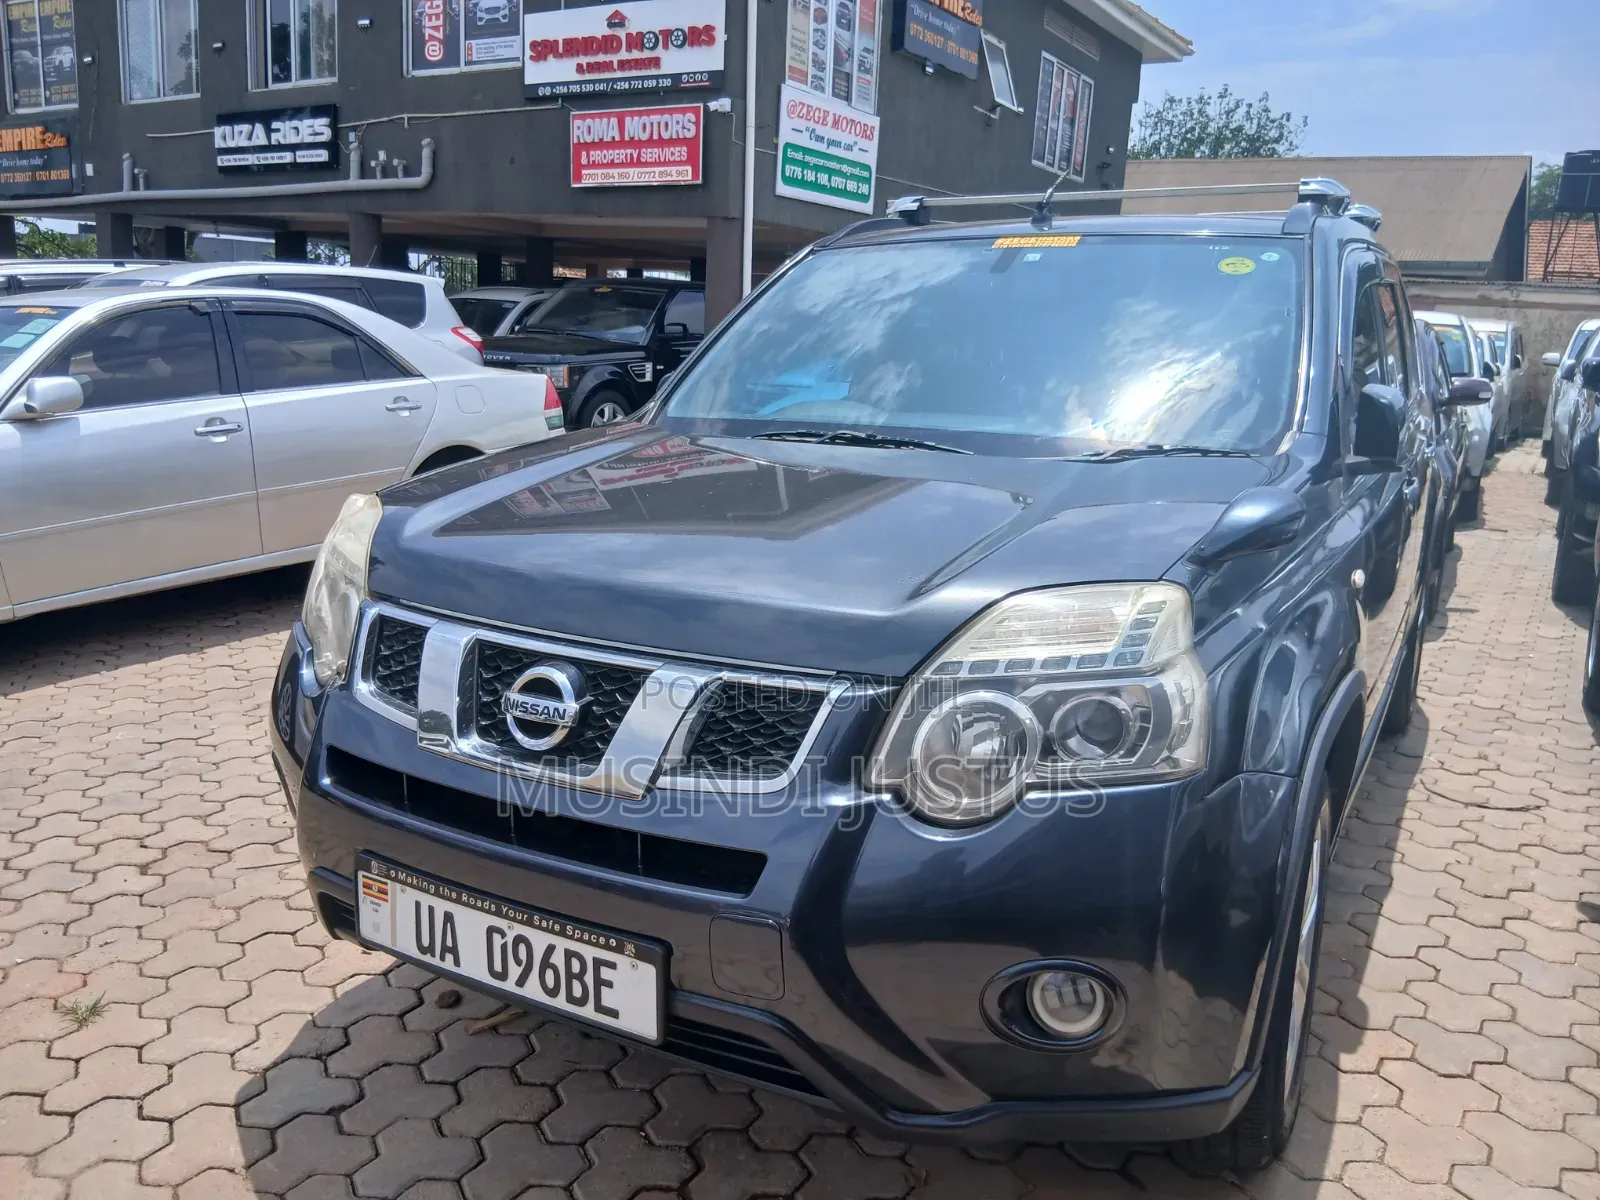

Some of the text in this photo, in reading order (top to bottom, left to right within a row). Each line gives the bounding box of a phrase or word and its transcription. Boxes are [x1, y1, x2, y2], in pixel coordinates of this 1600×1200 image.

[529, 24, 716, 63] SPLENDID MOTORS
[576, 56, 661, 75] & REAL ESTATE
[552, 85, 568, 94] +256
[569, 84, 580, 93] 705
[582, 83, 594, 92] 530
[595, 82, 607, 91] 041
[613, 81, 629, 90] +256
[630, 80, 642, 89] 772
[643, 79, 657, 88] 059
[658, 78, 672, 87] 330
[573, 112, 697, 144] ROMA MOTORS
[786, 99, 876, 141] @ZEGE MOTORS
[0, 125, 69, 152] MPIRE Rides
[214, 118, 332, 148] KUZA RIDES
[826, 137, 842, 150] your
[16, 157, 30, 167] home
[581, 146, 688, 165] & PROPERTY SERVICES
[787, 148, 803, 162] Email:
[1, 172, 14, 183] 0772
[36, 171, 49, 181] 0701
[582, 169, 689, 181] 0701 084 160 / 0772 894 961
[785, 164, 802, 180] 0776
[803, 168, 816, 183] 184
[830, 175, 846, 191] 0707
[858, 182, 870, 196] 240
[504, 697, 567, 721] NISSAN
[398, 870, 606, 945] Making the Roads Your Safe Space
[414, 899, 621, 1021] UA 096BE
